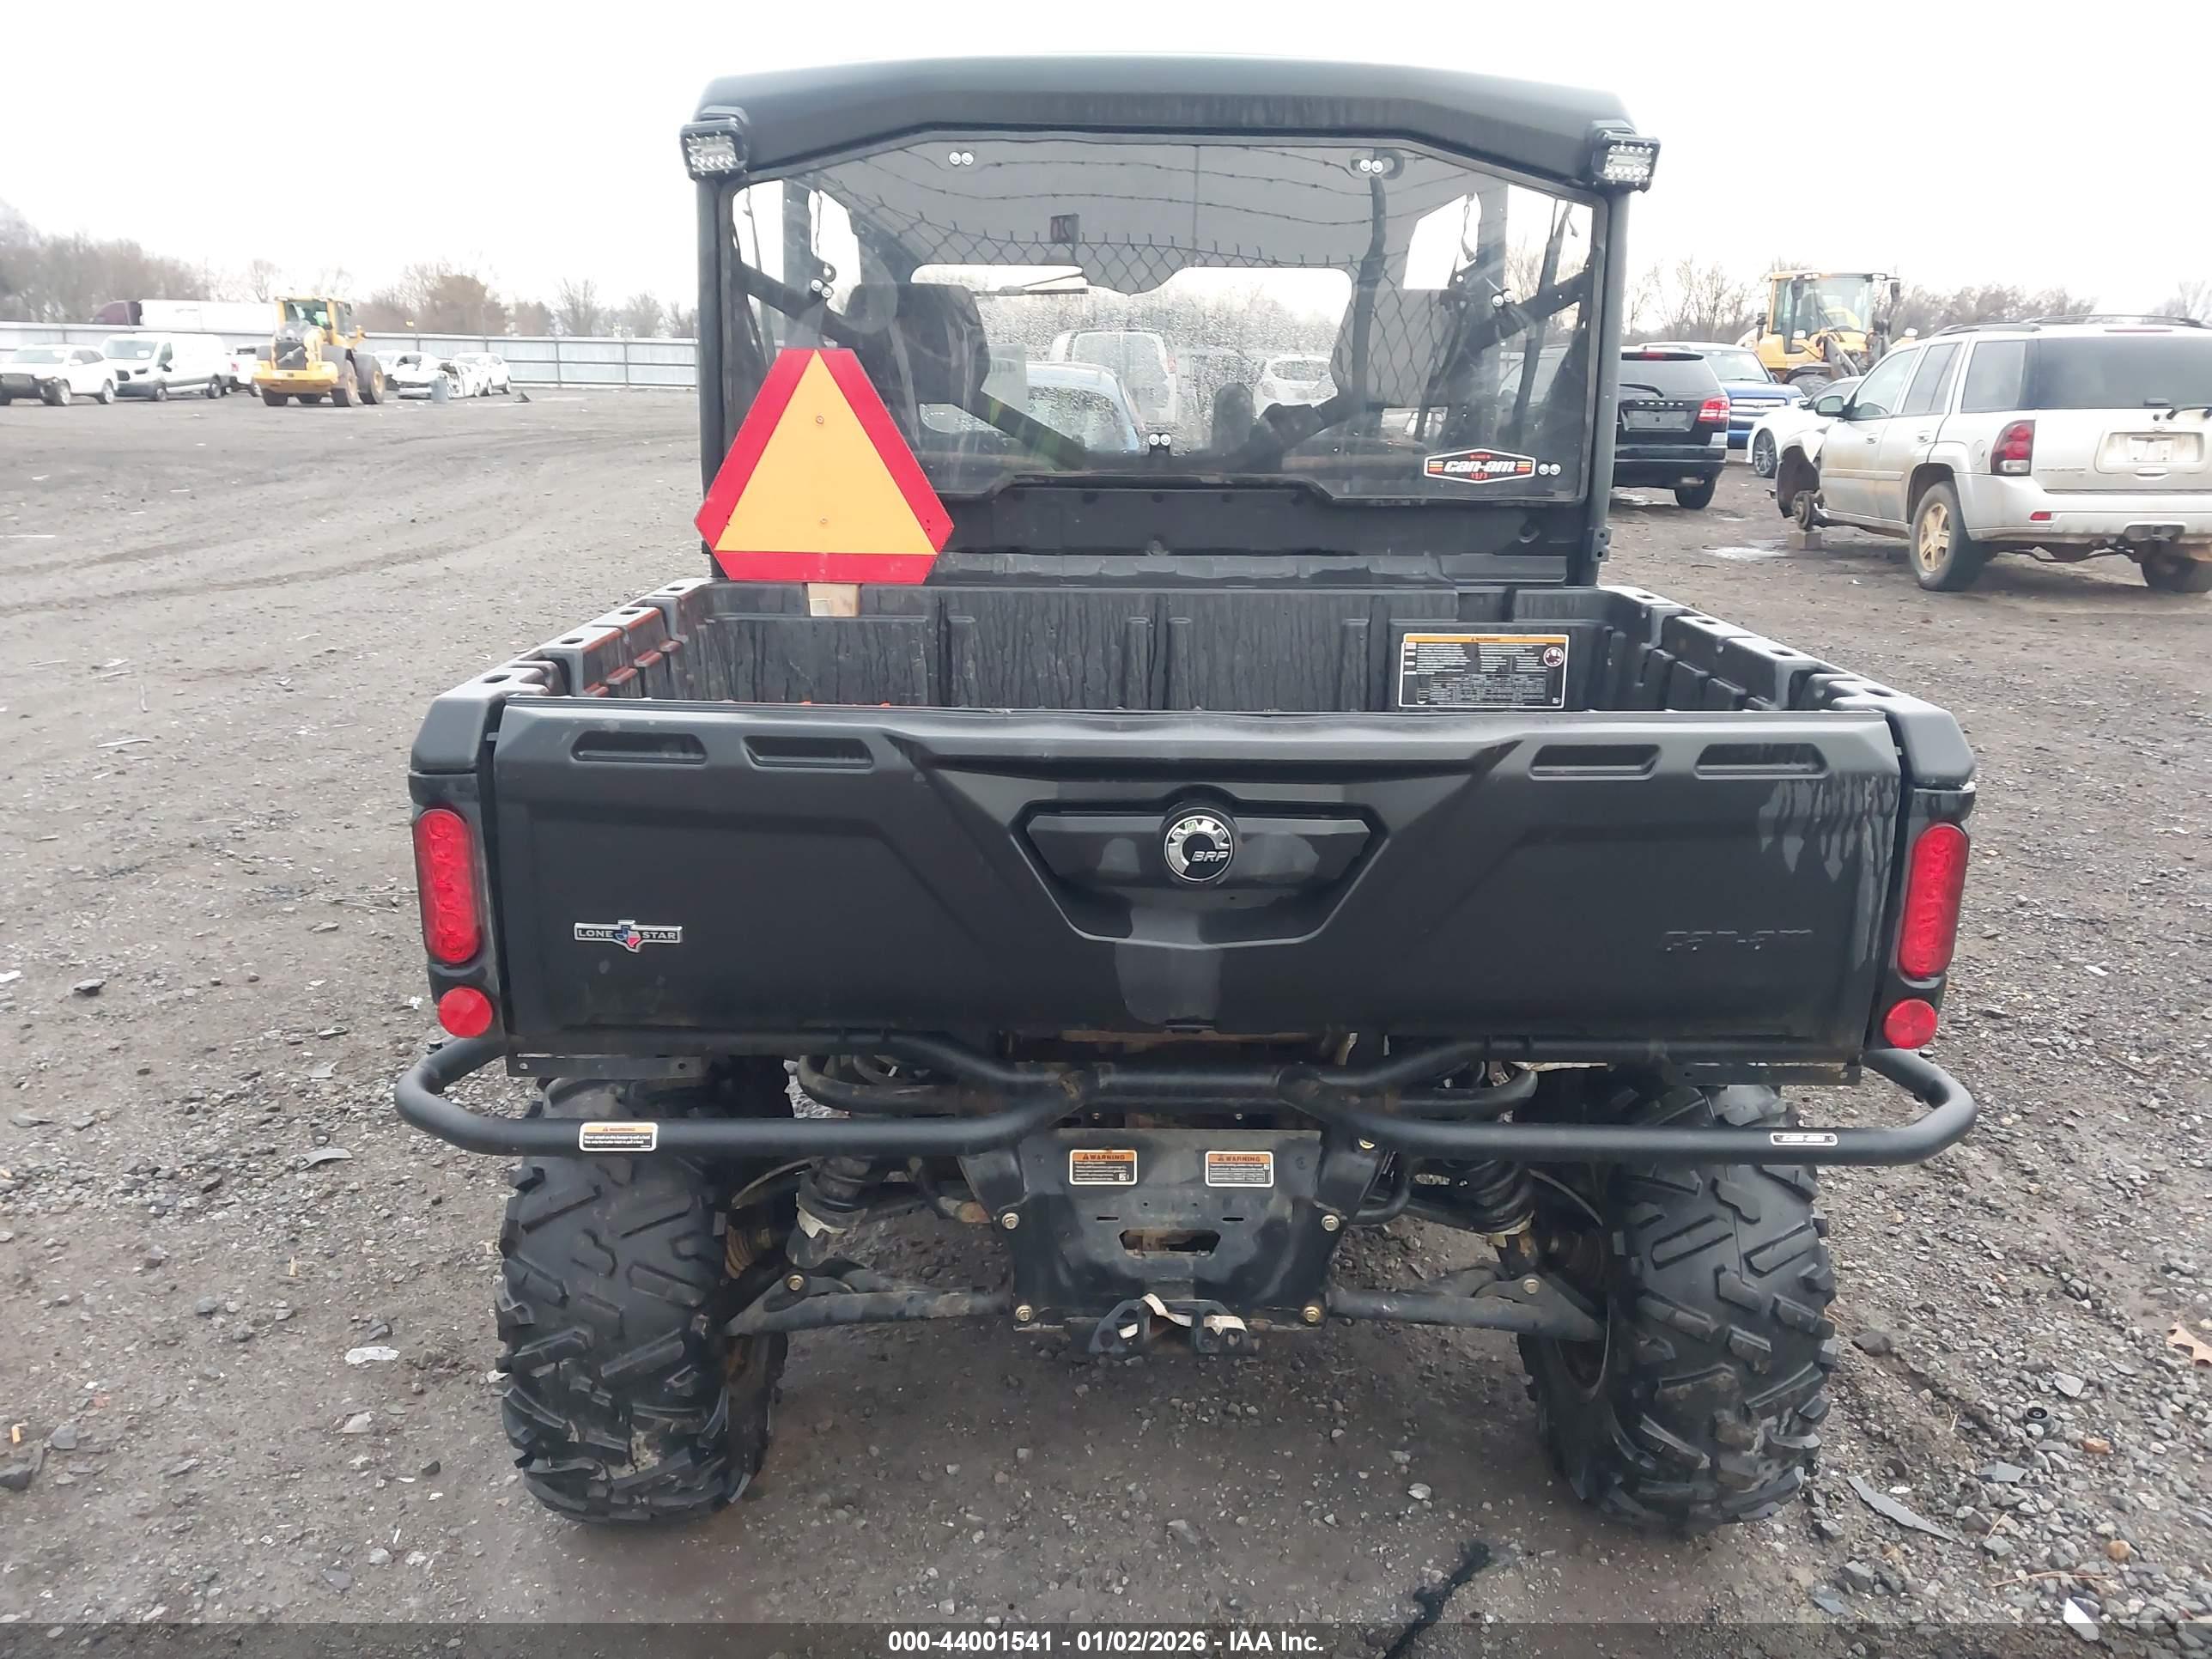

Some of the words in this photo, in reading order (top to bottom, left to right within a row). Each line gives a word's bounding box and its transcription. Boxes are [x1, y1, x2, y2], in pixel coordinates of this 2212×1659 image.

[1443, 460, 1516, 473] can-am
[1191, 850, 1229, 862] BRP
[578, 929, 614, 938] LONE
[641, 931, 677, 940] STAR
